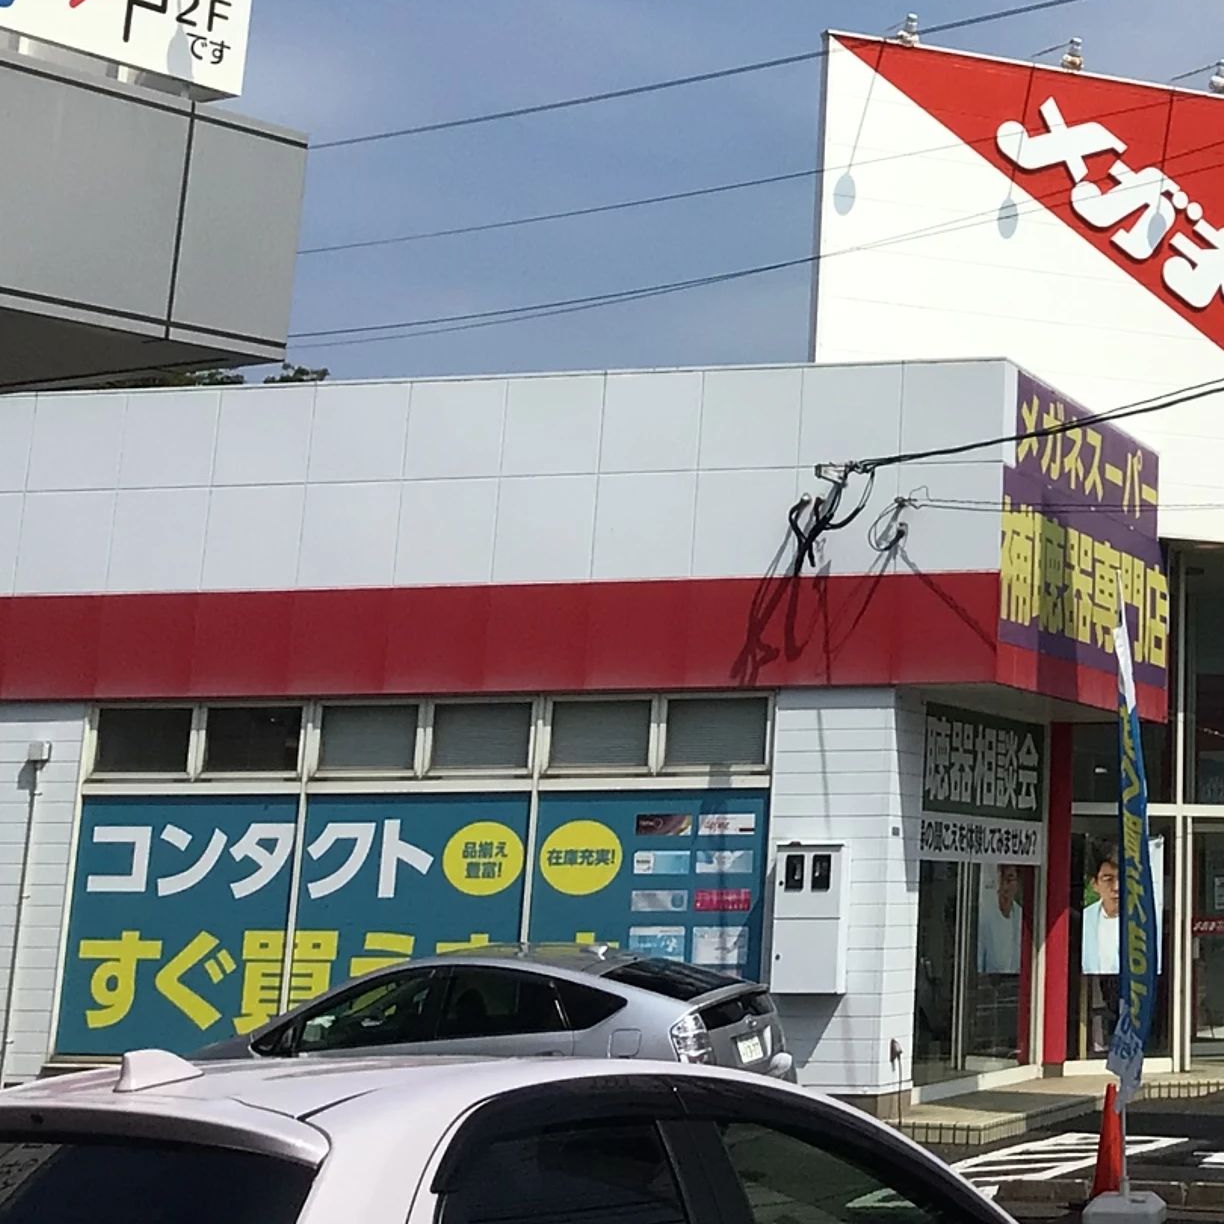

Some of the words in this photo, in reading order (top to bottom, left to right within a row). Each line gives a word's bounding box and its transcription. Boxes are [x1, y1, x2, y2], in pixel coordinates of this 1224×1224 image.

[186, 33, 231, 64] です
[1017, 395, 1157, 519] メガネスーパー
[1001, 495, 1170, 668] 補聴器専門店
[86, 819, 433, 899] コンタクト
